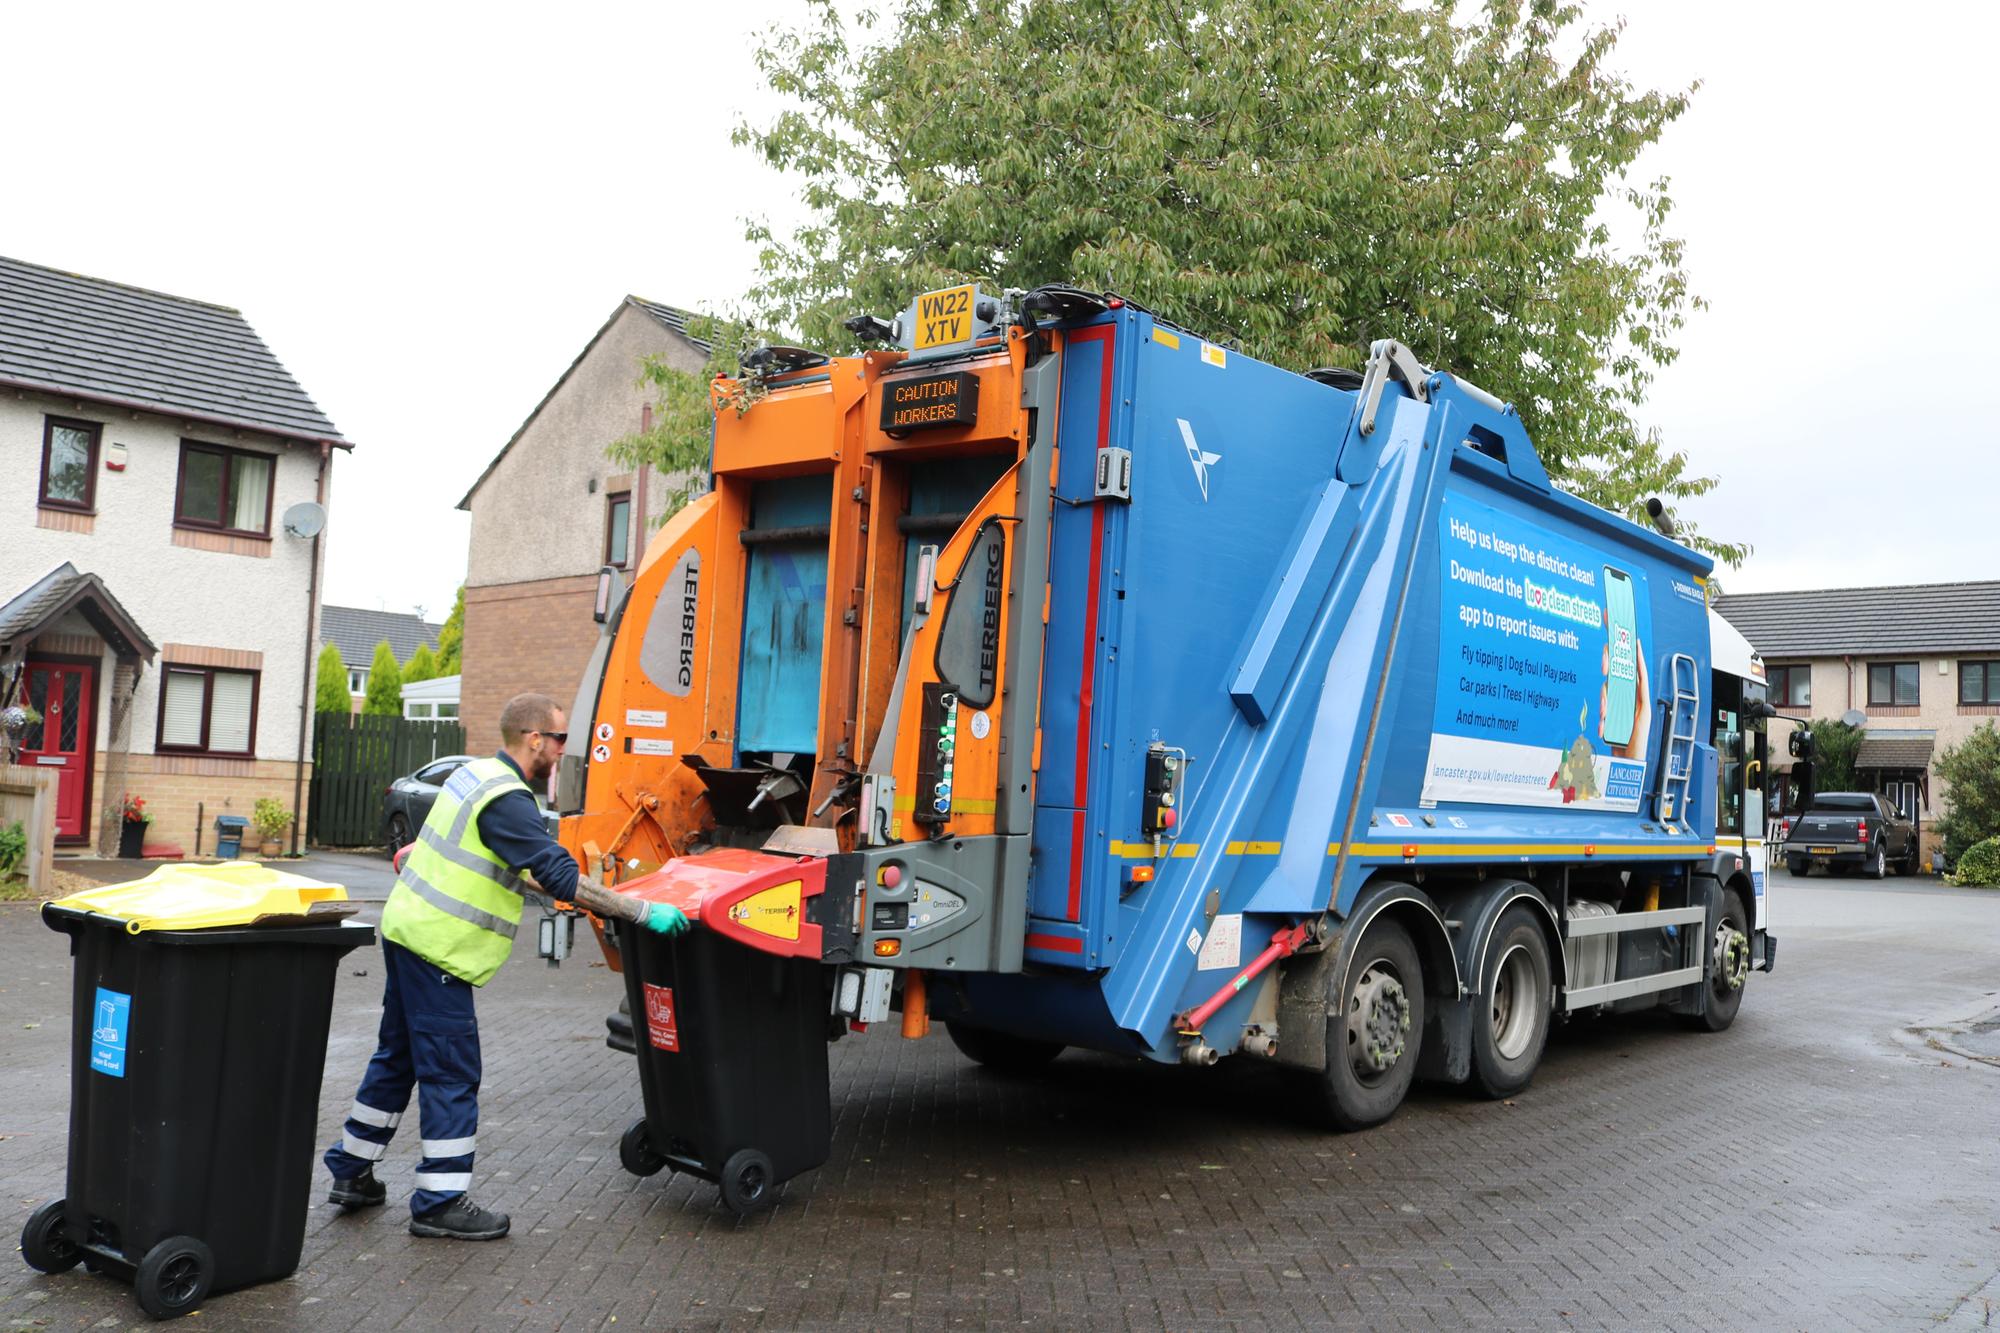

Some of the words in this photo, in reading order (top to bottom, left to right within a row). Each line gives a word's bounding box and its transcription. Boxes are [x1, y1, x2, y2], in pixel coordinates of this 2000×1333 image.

[922, 291, 968, 320] VN22
[925, 317, 960, 344] XTV
[896, 380, 958, 402] CAUTION
[894, 404, 957, 426] WORKERS
[1450, 518, 1476, 549] Help
[1478, 532, 1491, 550] us
[1492, 532, 1518, 562] keep
[1519, 544, 1536, 565] the
[1537, 549, 1568, 578] district
[1570, 564, 1594, 586] clean!
[1450, 559, 1504, 594] Download
[1506, 578, 1523, 600] the
[1548, 588, 1571, 616] clean
[1572, 596, 1600, 626] streets
[980, 544, 1000, 690] TERBERG
[1460, 604, 1480, 628] app
[1482, 609, 1494, 628] to
[1496, 615, 1528, 637] report
[1529, 620, 1556, 644] issues
[1558, 630, 1579, 650] with:
[1462, 645, 1474, 664] Fly
[1476, 648, 1503, 672] tipping
[1508, 656, 1523, 676] Dog
[1524, 659, 1538, 676] foul
[1544, 664, 1558, 683] Play
[1558, 669, 1576, 684] parks
[1460, 677, 1474, 692] Car
[1475, 682, 1496, 698] parks
[1502, 684, 1522, 702] Trees
[1528, 690, 1560, 711] Highways
[1456, 708, 1474, 725] And
[1474, 714, 1496, 728] much
[1498, 718, 1519, 732] more!
[1434, 764, 1548, 786] lancaster.gov.uk/lovecleanstreets
[1610, 766, 1642, 782] LANCASTER
